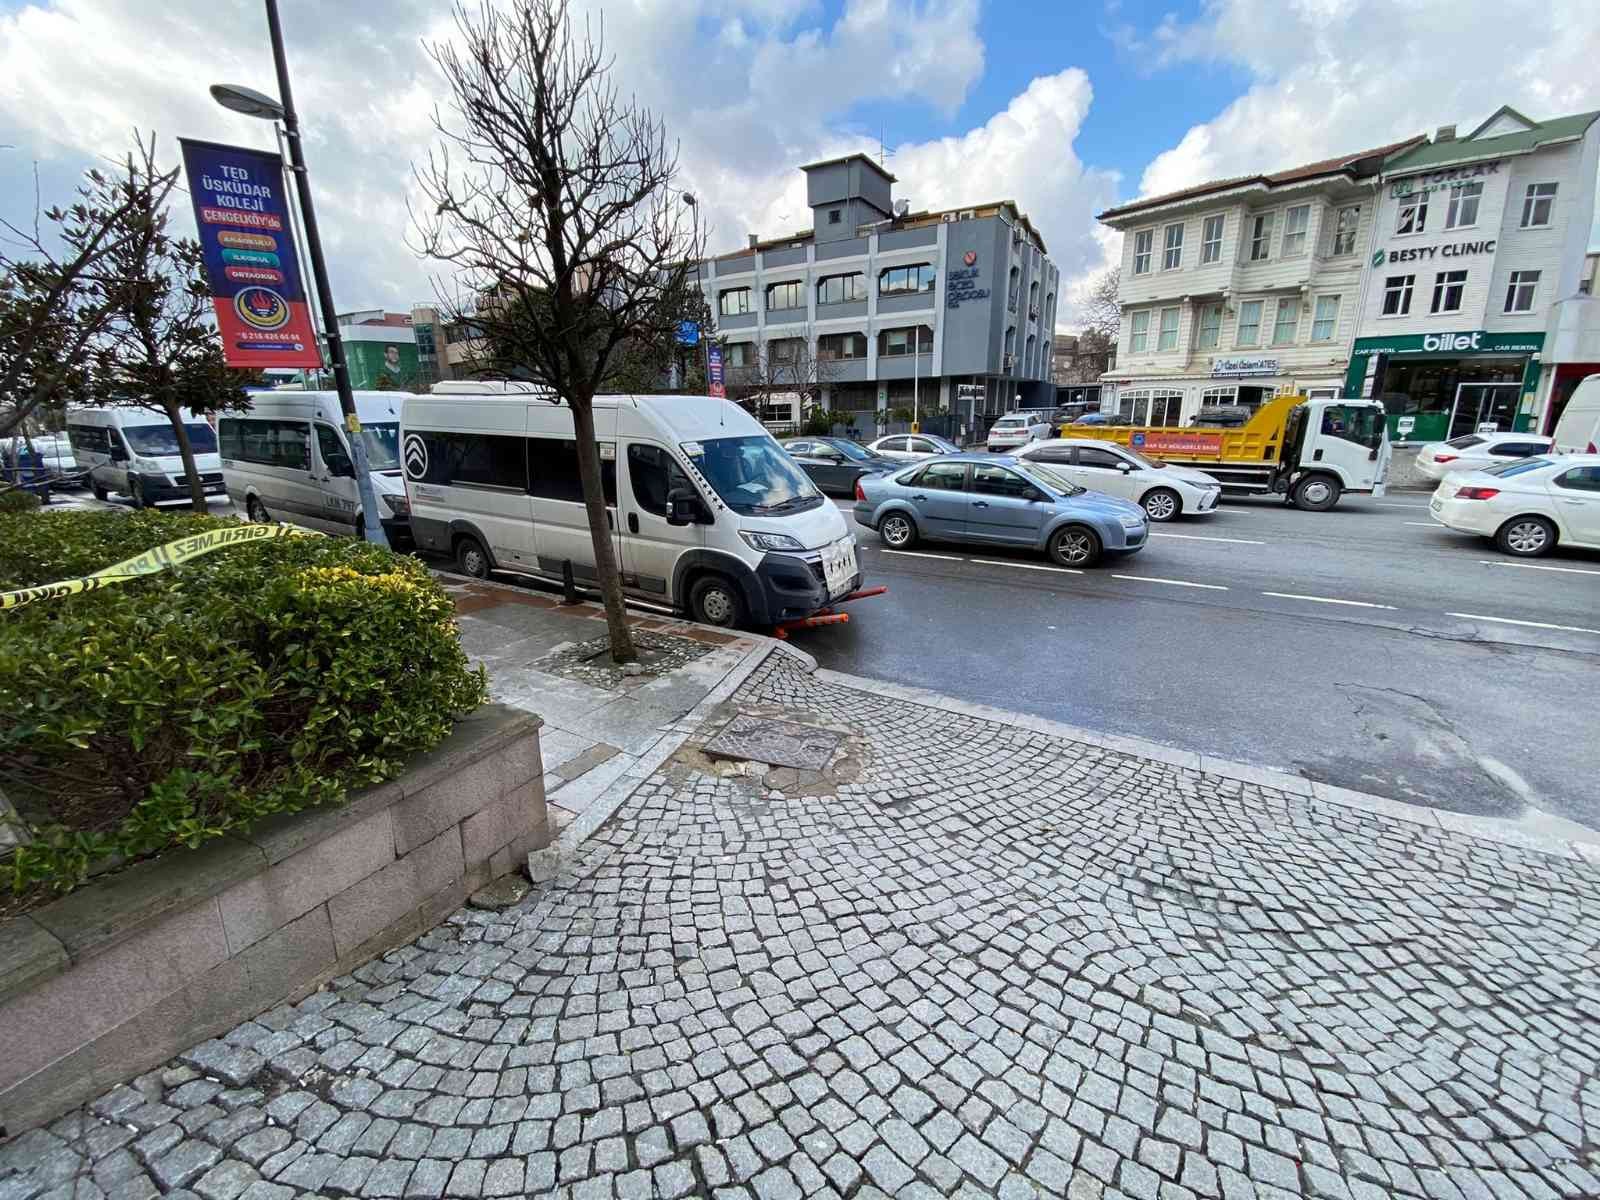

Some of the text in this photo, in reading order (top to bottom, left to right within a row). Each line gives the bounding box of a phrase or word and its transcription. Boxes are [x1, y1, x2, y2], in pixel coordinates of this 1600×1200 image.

[220, 165, 248, 180] TED
[202, 174, 272, 199] ÜSKÜDAR
[216, 194, 264, 212] KOLEJİ
[1389, 240, 1496, 263] BESTY CLINIC
[1423, 332, 1483, 351] billet
